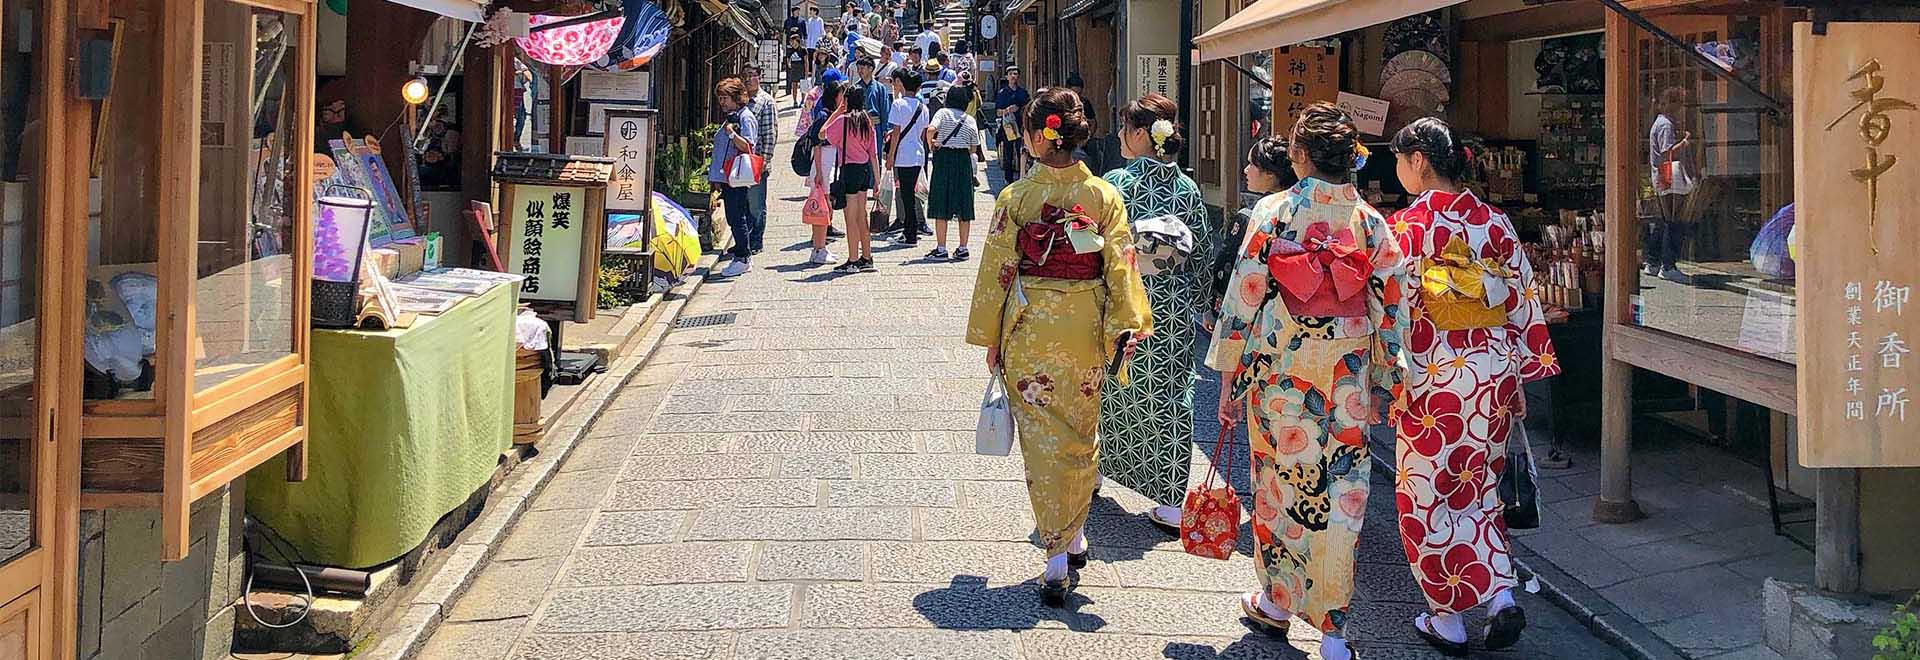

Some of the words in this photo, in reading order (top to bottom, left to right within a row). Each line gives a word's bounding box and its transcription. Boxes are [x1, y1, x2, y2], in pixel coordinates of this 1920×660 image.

[1353, 109, 1384, 122] Nagomi
[551, 192, 571, 229] 爆笑
[616, 145, 638, 201] 和傘屋
[521, 199, 545, 293] 似顔絵商店
[1845, 281, 1863, 420] 創業天正年間
[1872, 280, 1910, 422] 御香所
